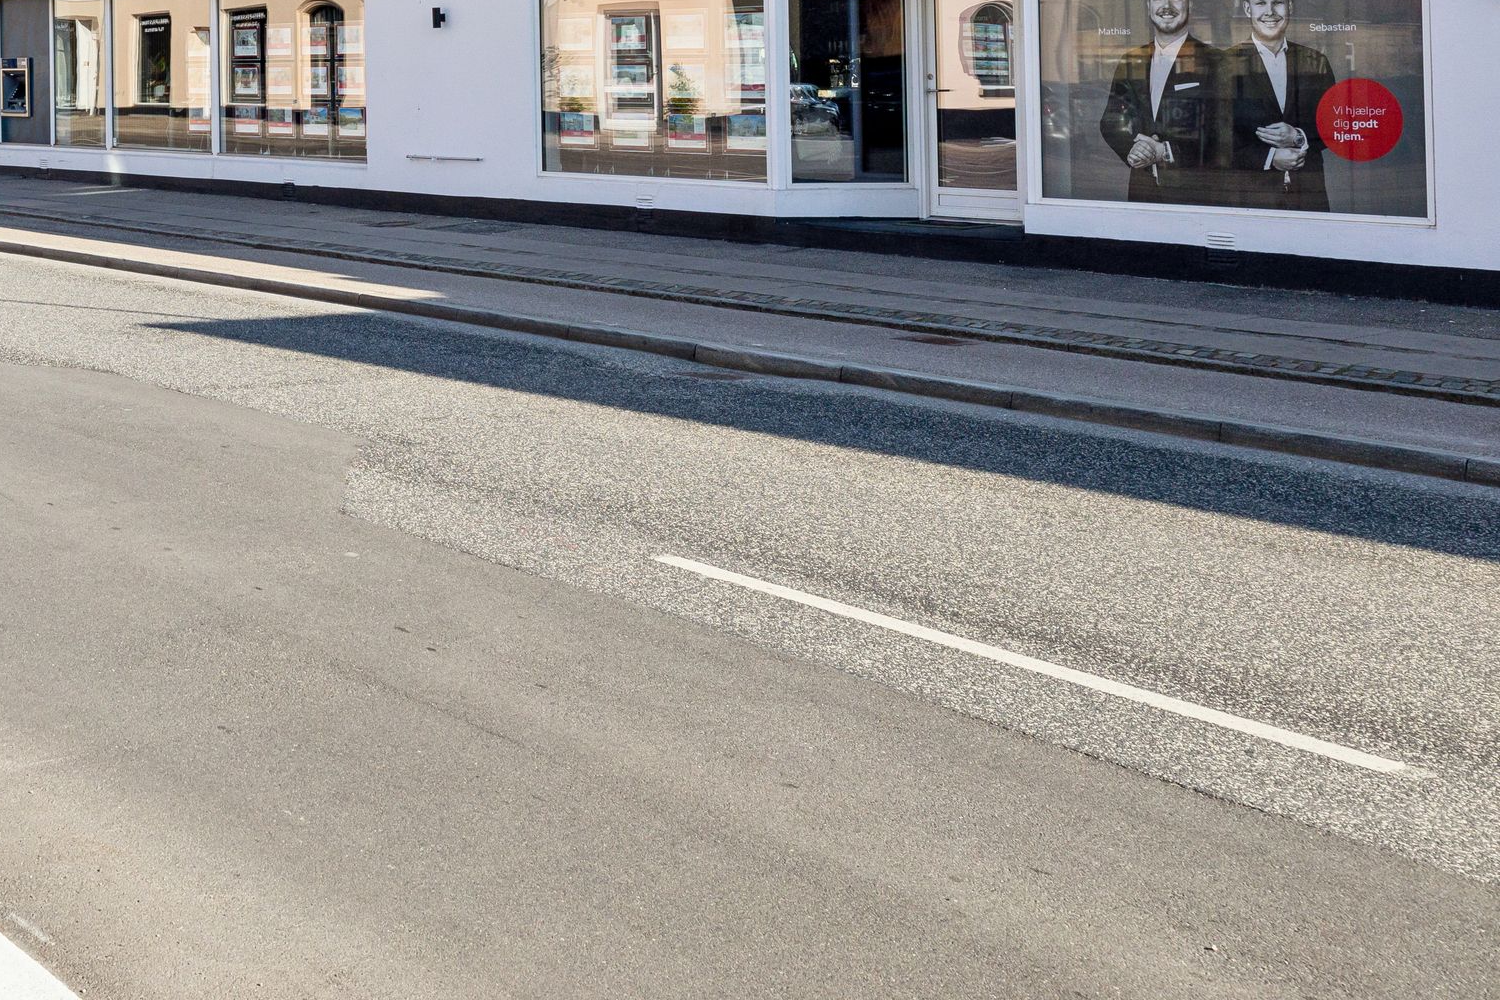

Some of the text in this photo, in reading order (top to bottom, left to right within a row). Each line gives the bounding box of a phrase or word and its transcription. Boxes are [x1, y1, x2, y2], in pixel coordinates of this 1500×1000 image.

[1098, 27, 1132, 36] Mathias
[1309, 23, 1357, 32] Sebastian
[1332, 105, 1387, 118] Vi hjælper
[1333, 118, 1379, 131] dig godt
[1333, 131, 1365, 143] hjem.
